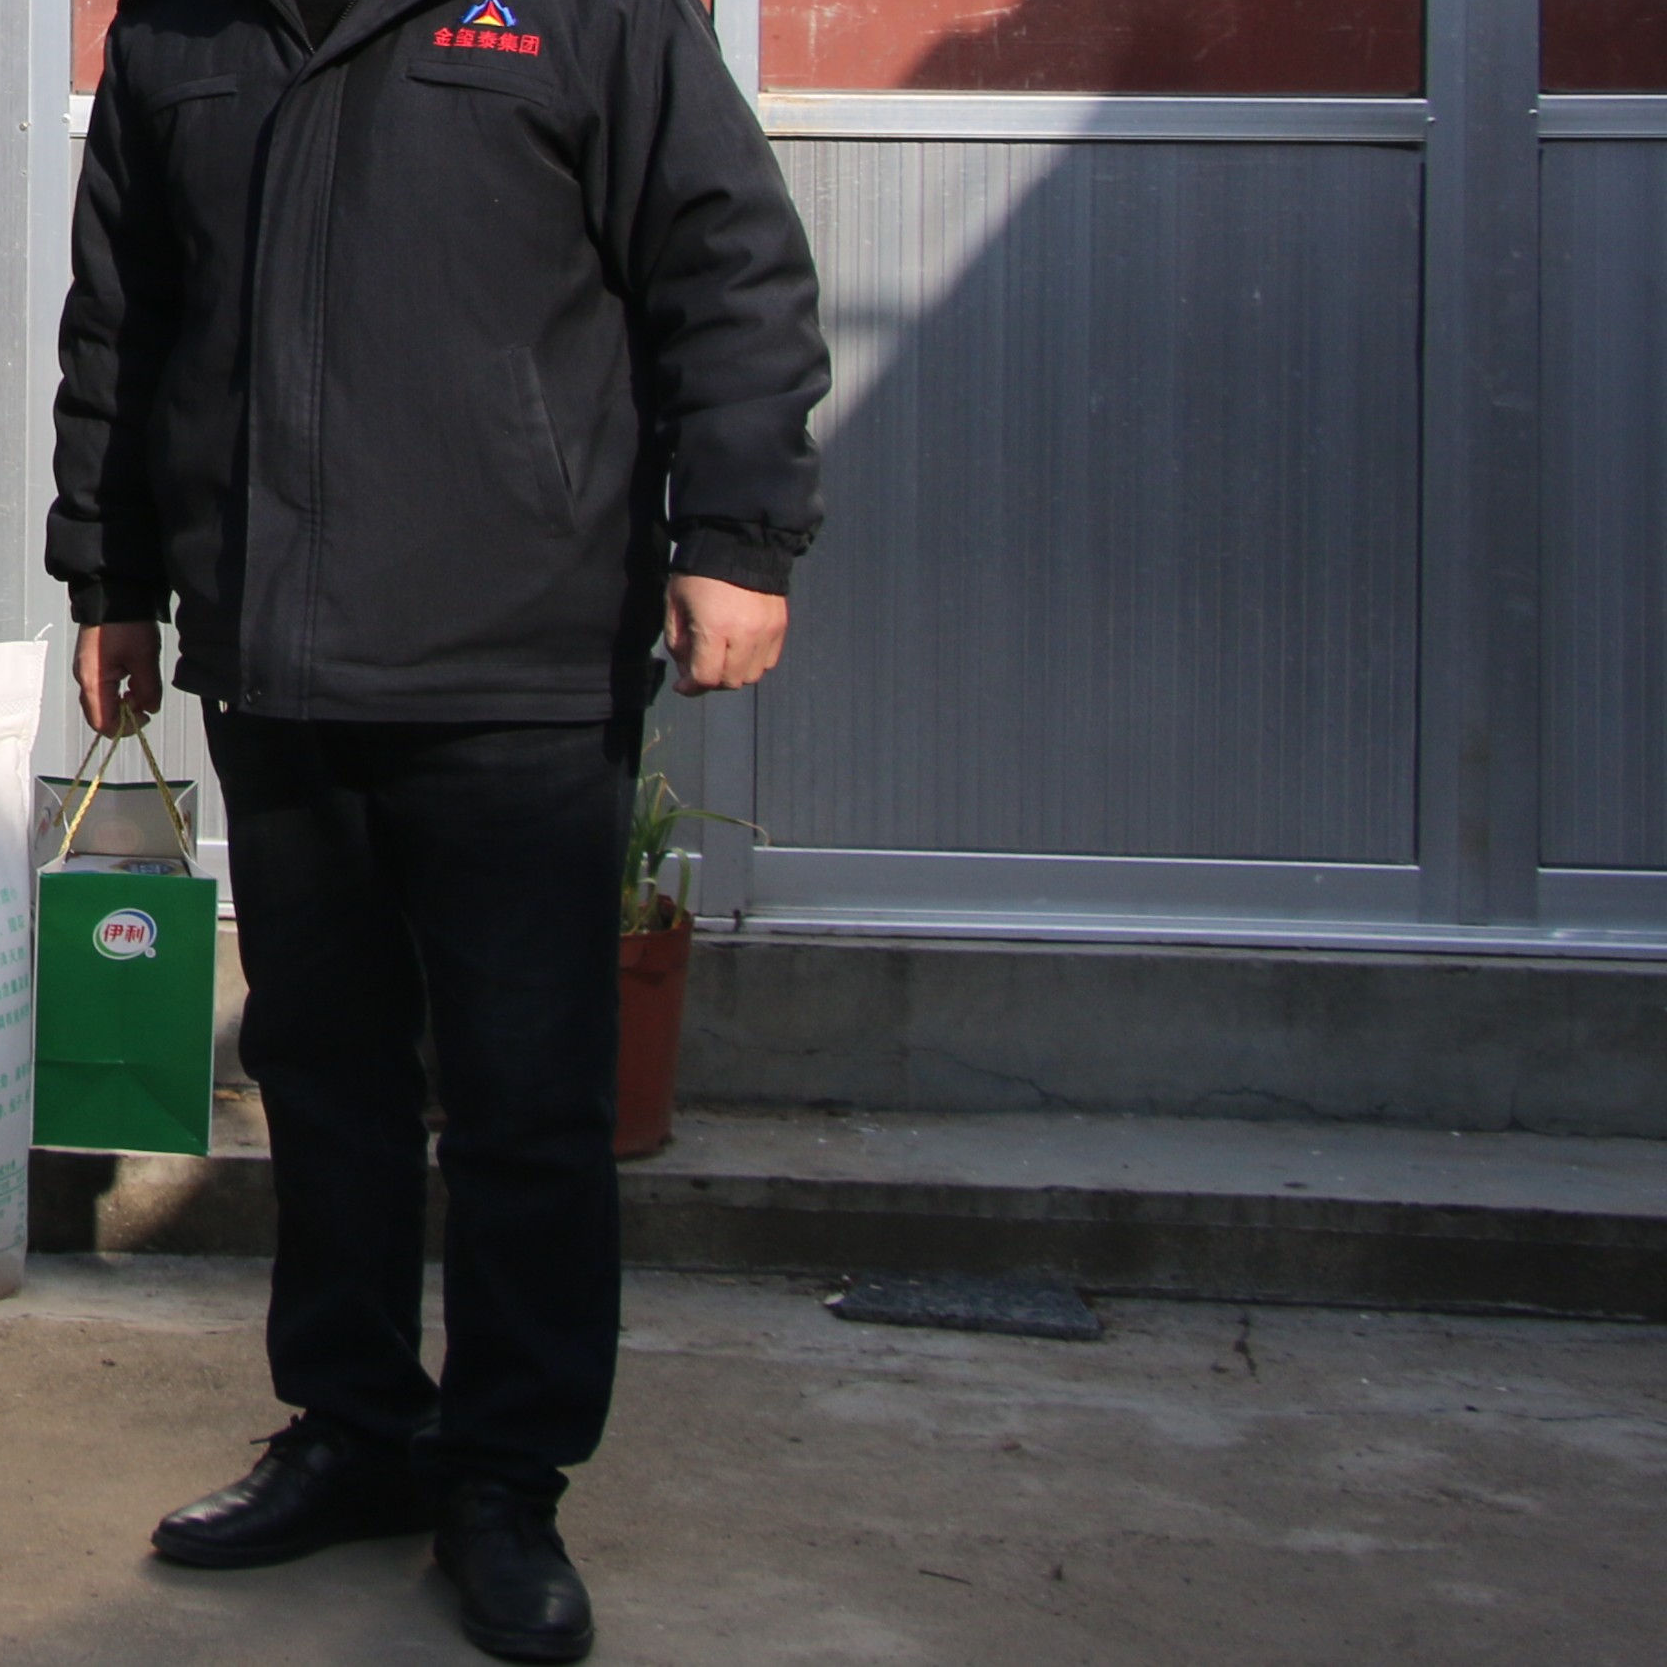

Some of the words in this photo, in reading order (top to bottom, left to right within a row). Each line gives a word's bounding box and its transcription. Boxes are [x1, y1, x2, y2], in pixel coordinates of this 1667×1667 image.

[433, 27, 540, 56] 金玺泰集团
[104, 923, 145, 943] 伊利
